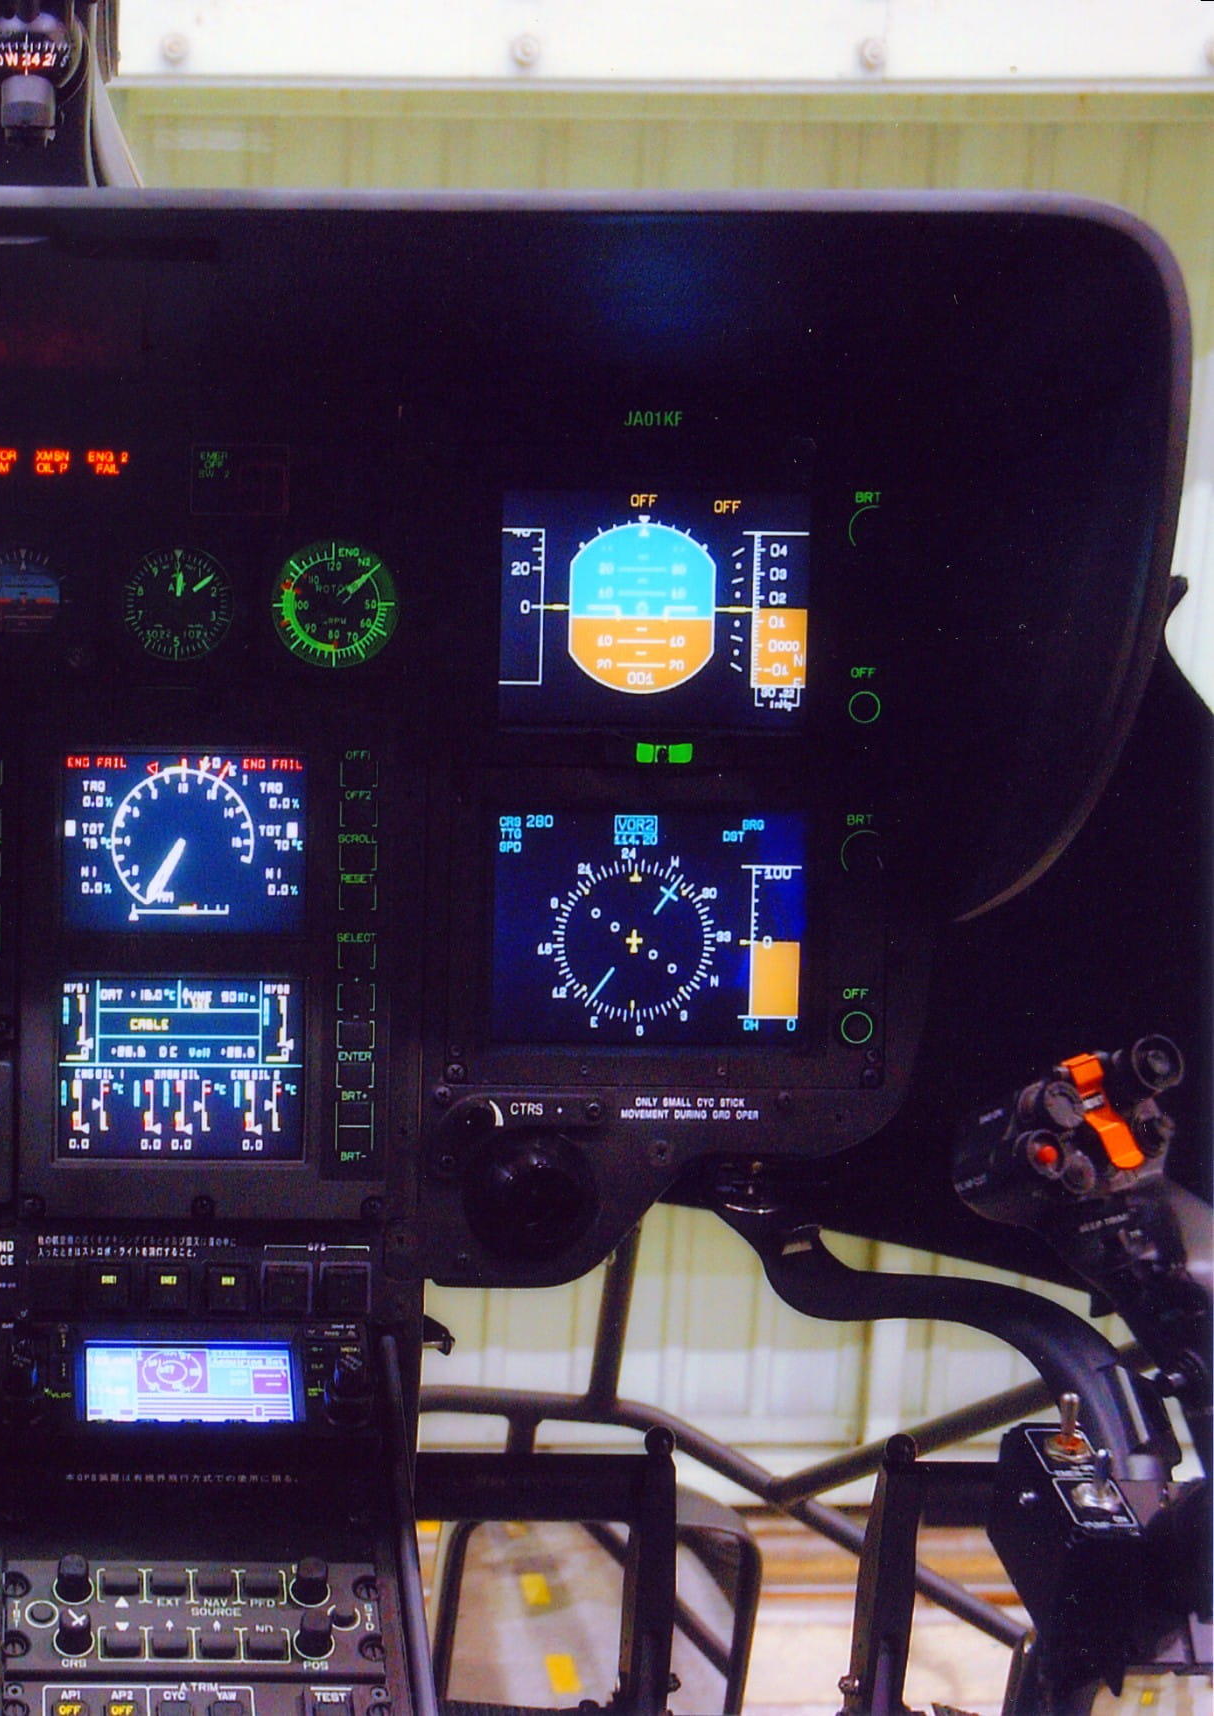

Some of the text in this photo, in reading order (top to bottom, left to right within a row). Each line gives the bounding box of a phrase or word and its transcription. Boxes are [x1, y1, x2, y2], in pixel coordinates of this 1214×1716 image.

[6, 53, 18, 67] W
[623, 410, 683, 427] JA01KF
[36, 450, 70, 462] XMSN
[88, 451, 129, 463] ENG 2
[36, 462, 68, 474] OIL P
[96, 463, 120, 475] FAIL
[630, 494, 741, 514] OFF OFF
[855, 492, 882, 504] BRT
[770, 544, 788, 557] 04
[850, 667, 876, 679] OFF
[67, 757, 127, 768] ENG FAIL
[242, 758, 303, 771] ENG FAIL
[499, 814, 554, 828] CRS 280
[617, 818, 656, 833] VOR2
[846, 814, 873, 826] BRT
[82, 823, 105, 835] TOT
[258, 825, 281, 837] TOT
[500, 828, 522, 840] TTG
[338, 833, 377, 844] SCROLL
[621, 848, 637, 859] 24
[337, 933, 377, 943] SELECT
[842, 988, 869, 1000] OFF
[129, 1018, 170, 1031] CABLE
[338, 1051, 372, 1062] ENTER
[635, 1097, 745, 1108] ONLY SMALL CYC STICK
[510, 1103, 543, 1115] CTRS
[621, 1109, 759, 1121] MOVEMENT DURING GRD OPER
[157, 1598, 181, 1607] EXT
[203, 1598, 228, 1608] NAV
[191, 1606, 241, 1617] SOURCE
[61, 1658, 86, 1668] CRS
[303, 1660, 329, 1670] POS
[190, 1682, 219, 1693] TRIM
[111, 1690, 134, 1700] AP2
[217, 1691, 237, 1701] YAW
[315, 1692, 347, 1702] TEST
[58, 1704, 82, 1715] OFF
[110, 1704, 134, 1715] OFF
